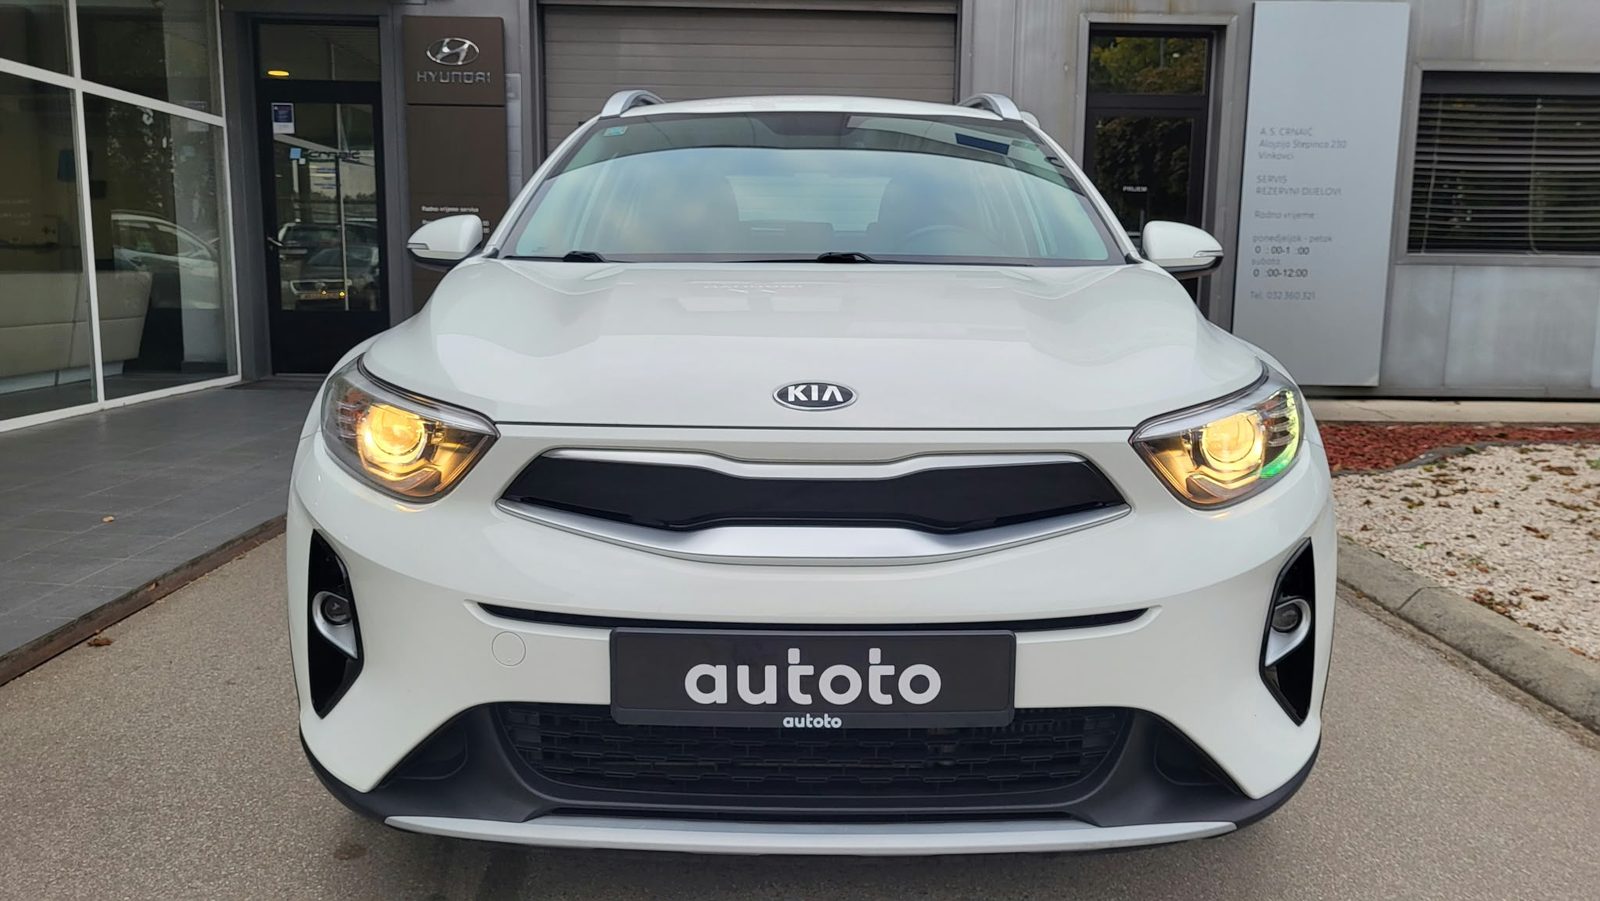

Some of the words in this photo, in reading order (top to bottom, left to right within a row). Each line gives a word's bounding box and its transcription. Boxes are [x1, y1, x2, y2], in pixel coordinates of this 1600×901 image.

[416, 71, 491, 84] HYUNDAI
[1255, 175, 1288, 184] SERVIS
[1255, 186, 1300, 196] REZERVNI
[787, 384, 844, 402] KIA
[685, 648, 942, 705] autoto
[782, 713, 843, 728] autoto
